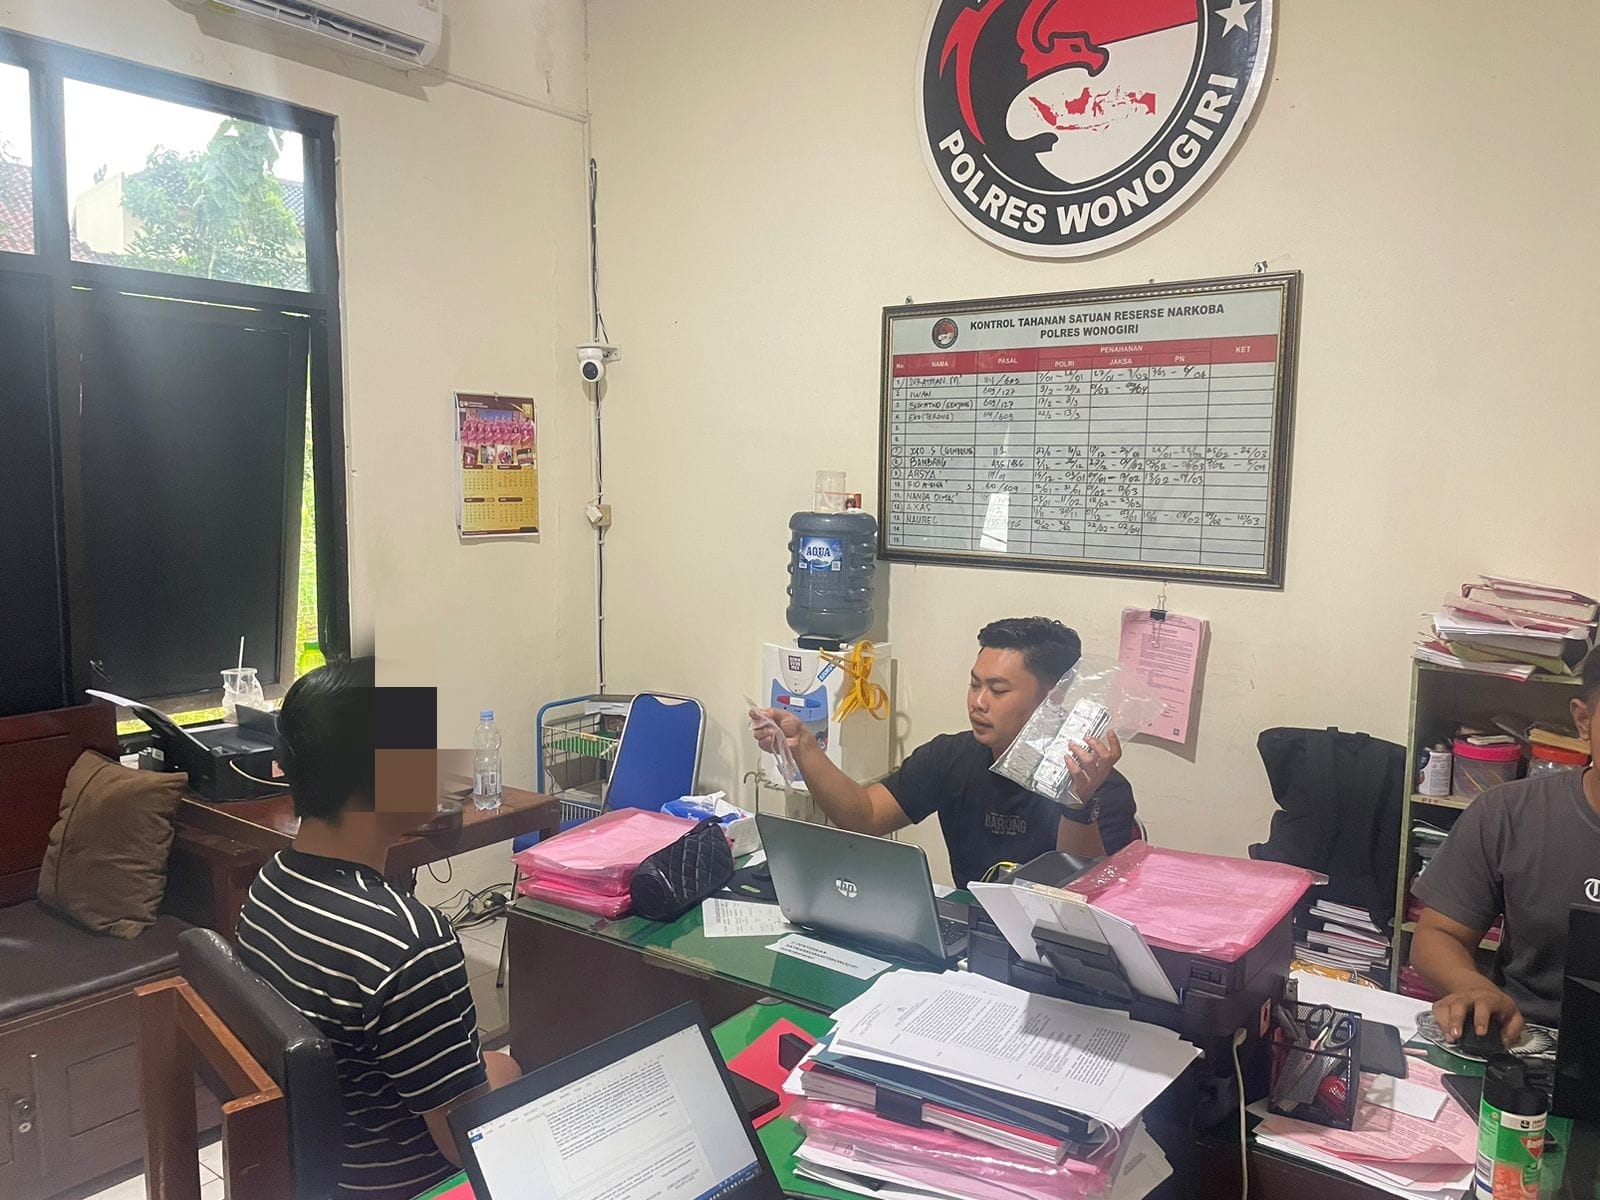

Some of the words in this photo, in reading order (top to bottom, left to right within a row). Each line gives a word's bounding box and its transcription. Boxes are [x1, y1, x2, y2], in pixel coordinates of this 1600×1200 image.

[938, 129, 1047, 235] POLRES
[1056, 73, 1239, 236] WONOGIRI
[969, 318, 1015, 331] KONTROL
[1018, 315, 1065, 328] TAHANAN
[1068, 311, 1111, 324] SATUAN
[1114, 308, 1164, 321] RESERSE
[1167, 304, 1224, 317] NARKOBA
[1040, 328, 1080, 339] POLRES
[1083, 324, 1139, 337] WONOGIRI
[1100, 344, 1143, 353] PENAHANAN
[1235, 346, 1251, 354] KET
[1110, 358, 1133, 366] JAKSA
[806, 546, 831, 558] AQUA
